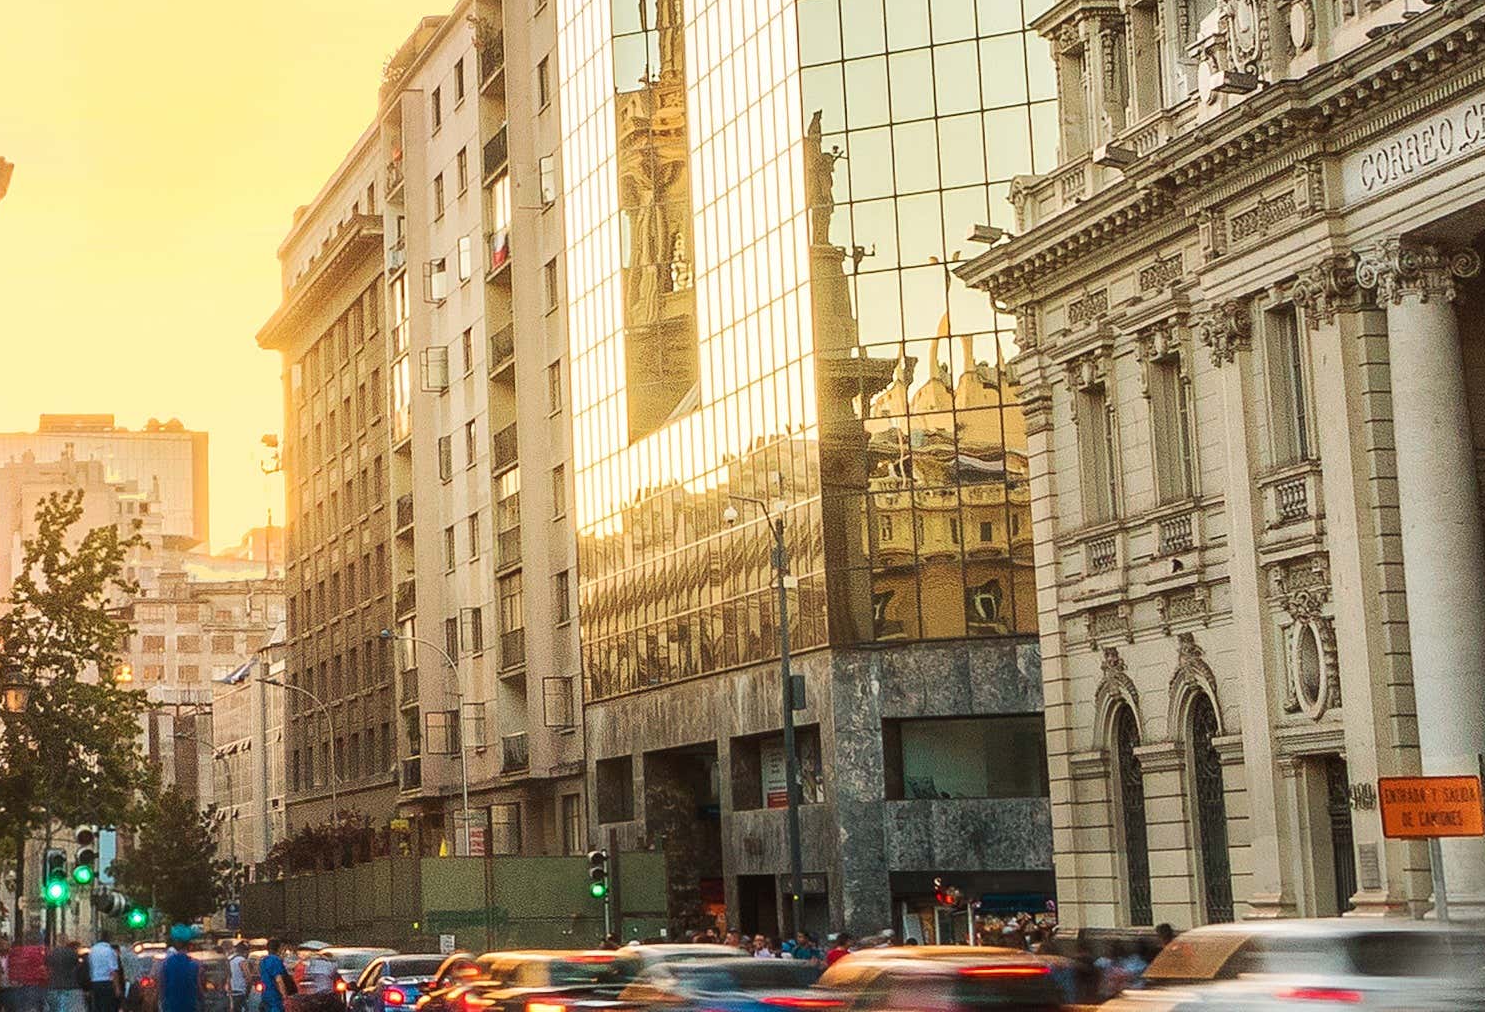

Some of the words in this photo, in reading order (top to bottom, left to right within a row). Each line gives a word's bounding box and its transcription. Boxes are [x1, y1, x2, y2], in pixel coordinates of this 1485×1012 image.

[1361, 117, 1454, 191] CORREO
[1384, 787, 1427, 804] ENTRADA
[1431, 787, 1438, 802] Y
[1443, 786, 1477, 803] SALIDA
[1401, 811, 1414, 828] DE
[1418, 809, 1463, 826] CAMIONES
